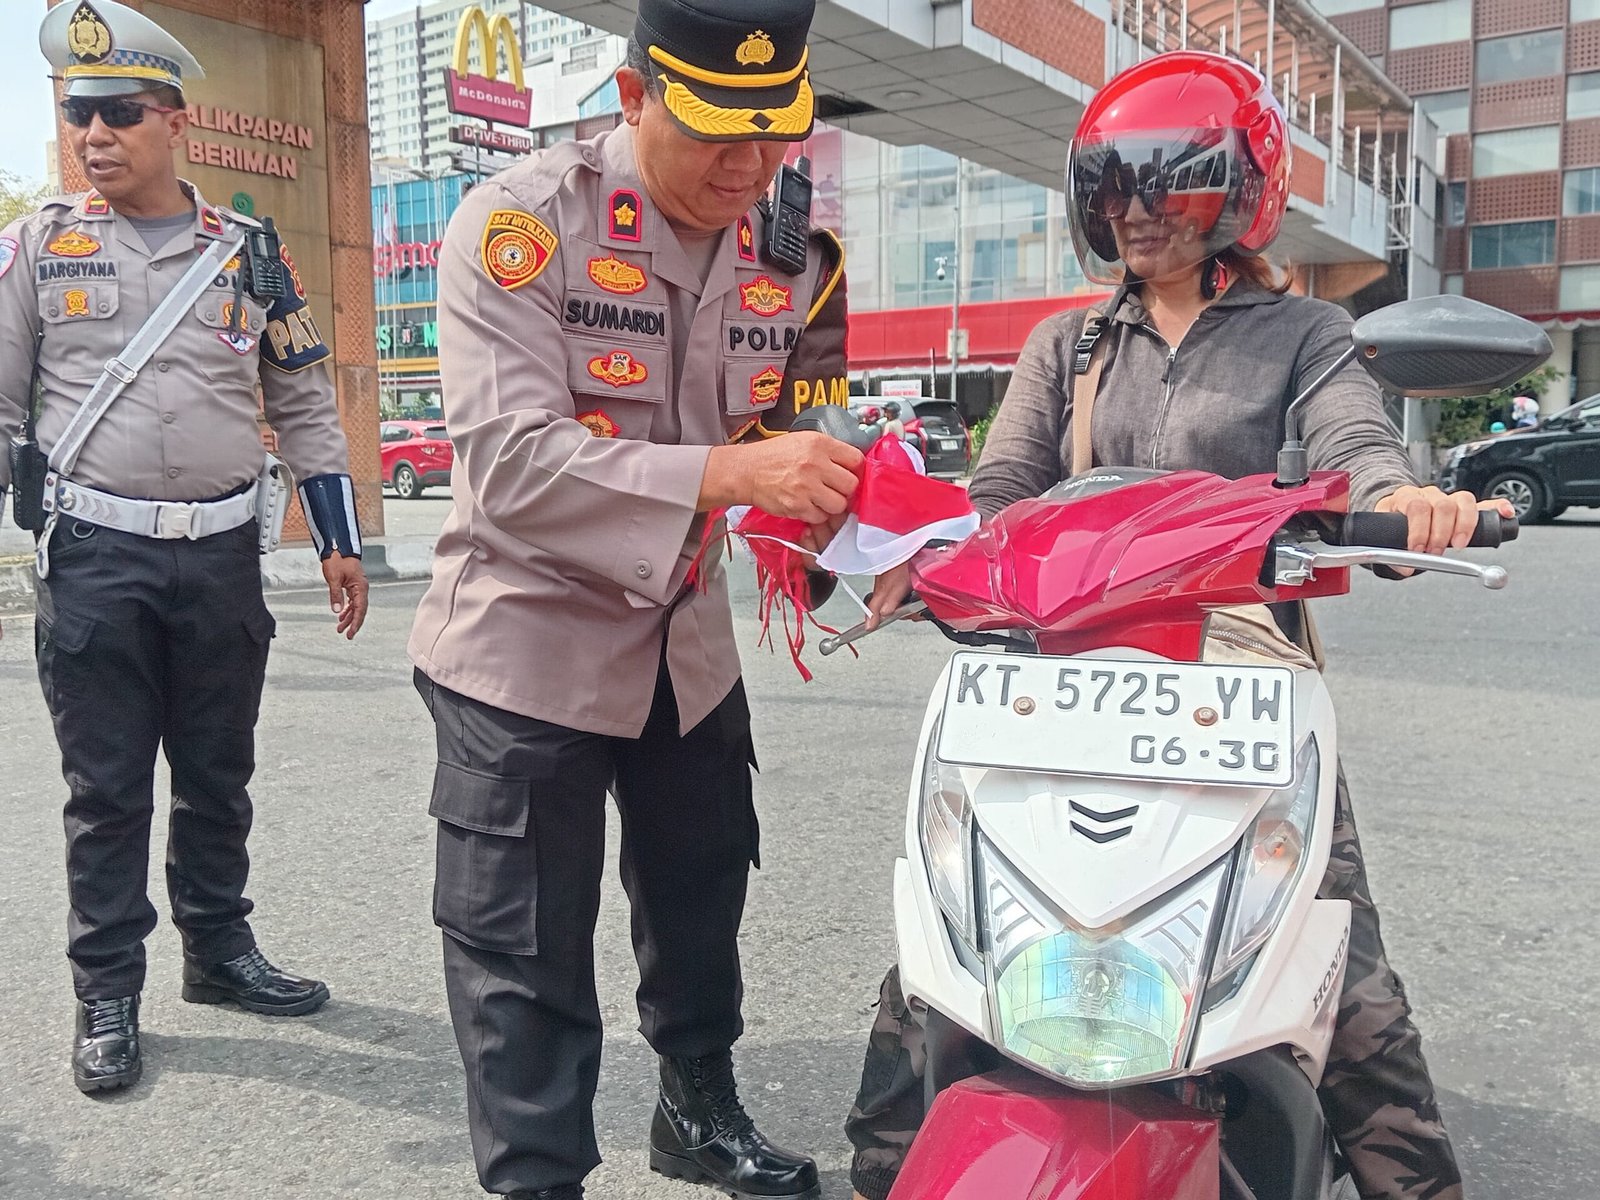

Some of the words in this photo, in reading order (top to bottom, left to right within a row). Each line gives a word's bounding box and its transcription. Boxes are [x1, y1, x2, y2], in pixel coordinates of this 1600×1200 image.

[458, 86, 527, 111] McDonald's
[186, 103, 313, 150] ALIKPAPAN
[188, 140, 297, 179] BERIMAN
[492, 213, 513, 225] SAT
[566, 299, 665, 337] SUMARDI
[793, 376, 850, 416] PAM
[1063, 474, 1124, 491] HONDA
[957, 662, 1021, 707] KT
[1054, 667, 1181, 717] 5725
[1216, 676, 1282, 722] YW
